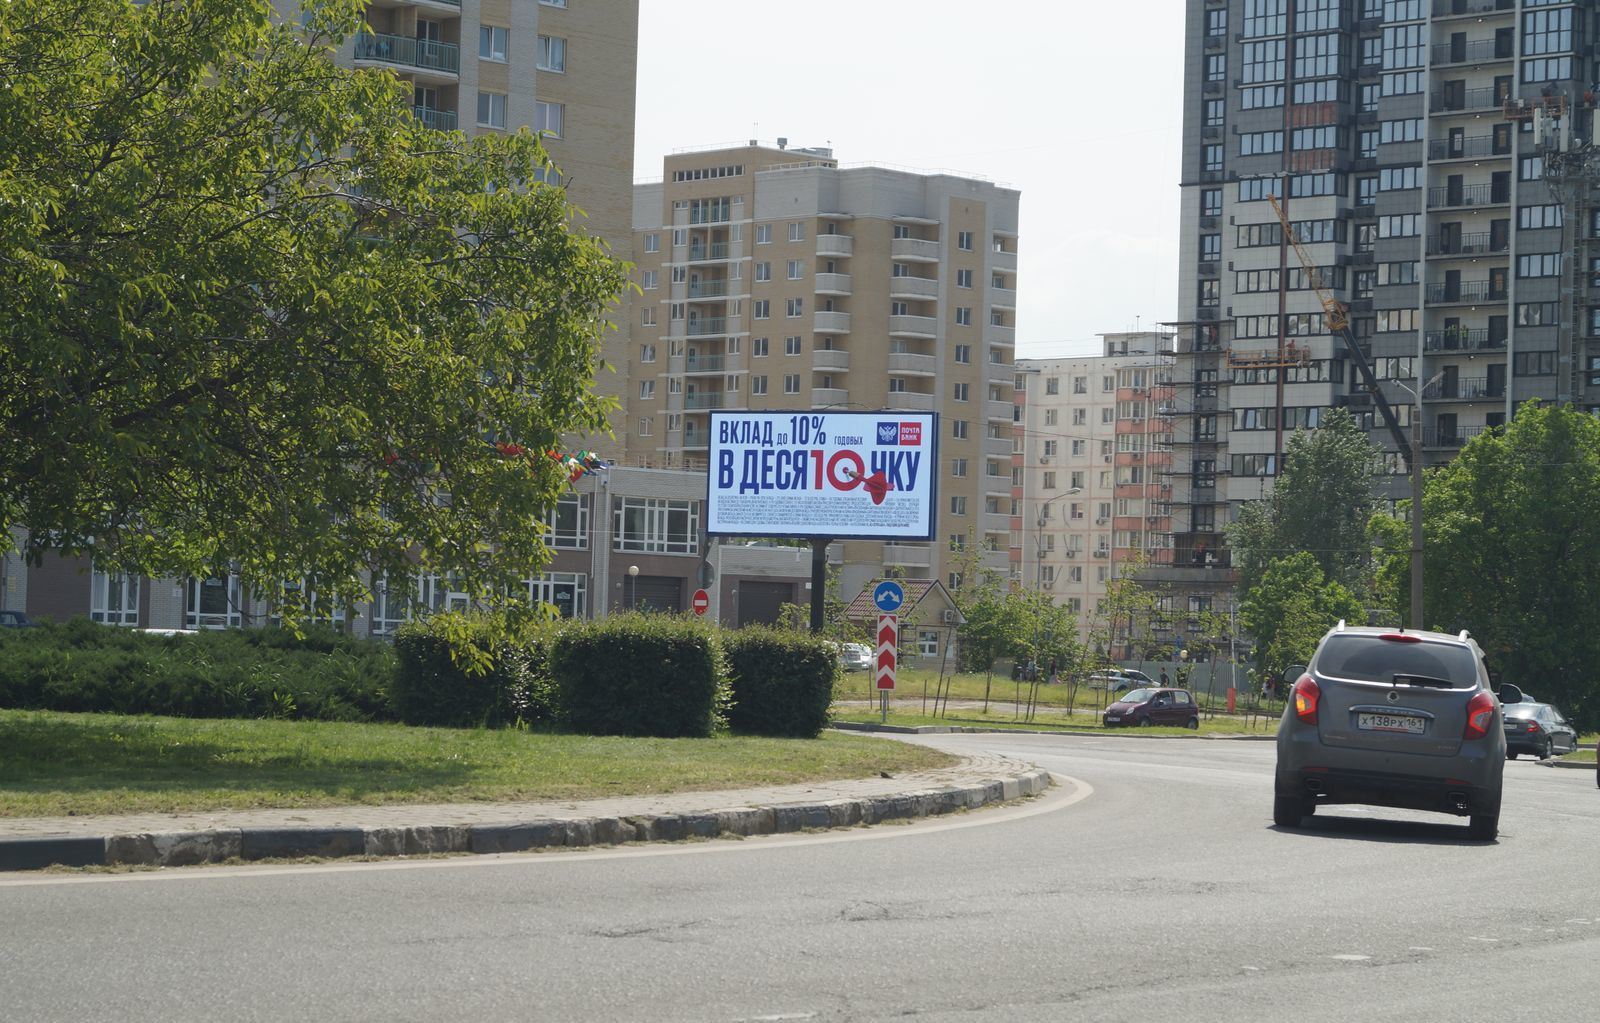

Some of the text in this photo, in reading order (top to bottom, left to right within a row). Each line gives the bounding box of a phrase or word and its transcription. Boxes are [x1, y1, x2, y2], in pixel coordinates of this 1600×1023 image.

[719, 420, 773, 447] ВКЛАД
[790, 415, 826, 445] 10%
[901, 426, 920, 434] ПОЧТА
[901, 433, 918, 441] БАНК
[718, 449, 734, 489] В
